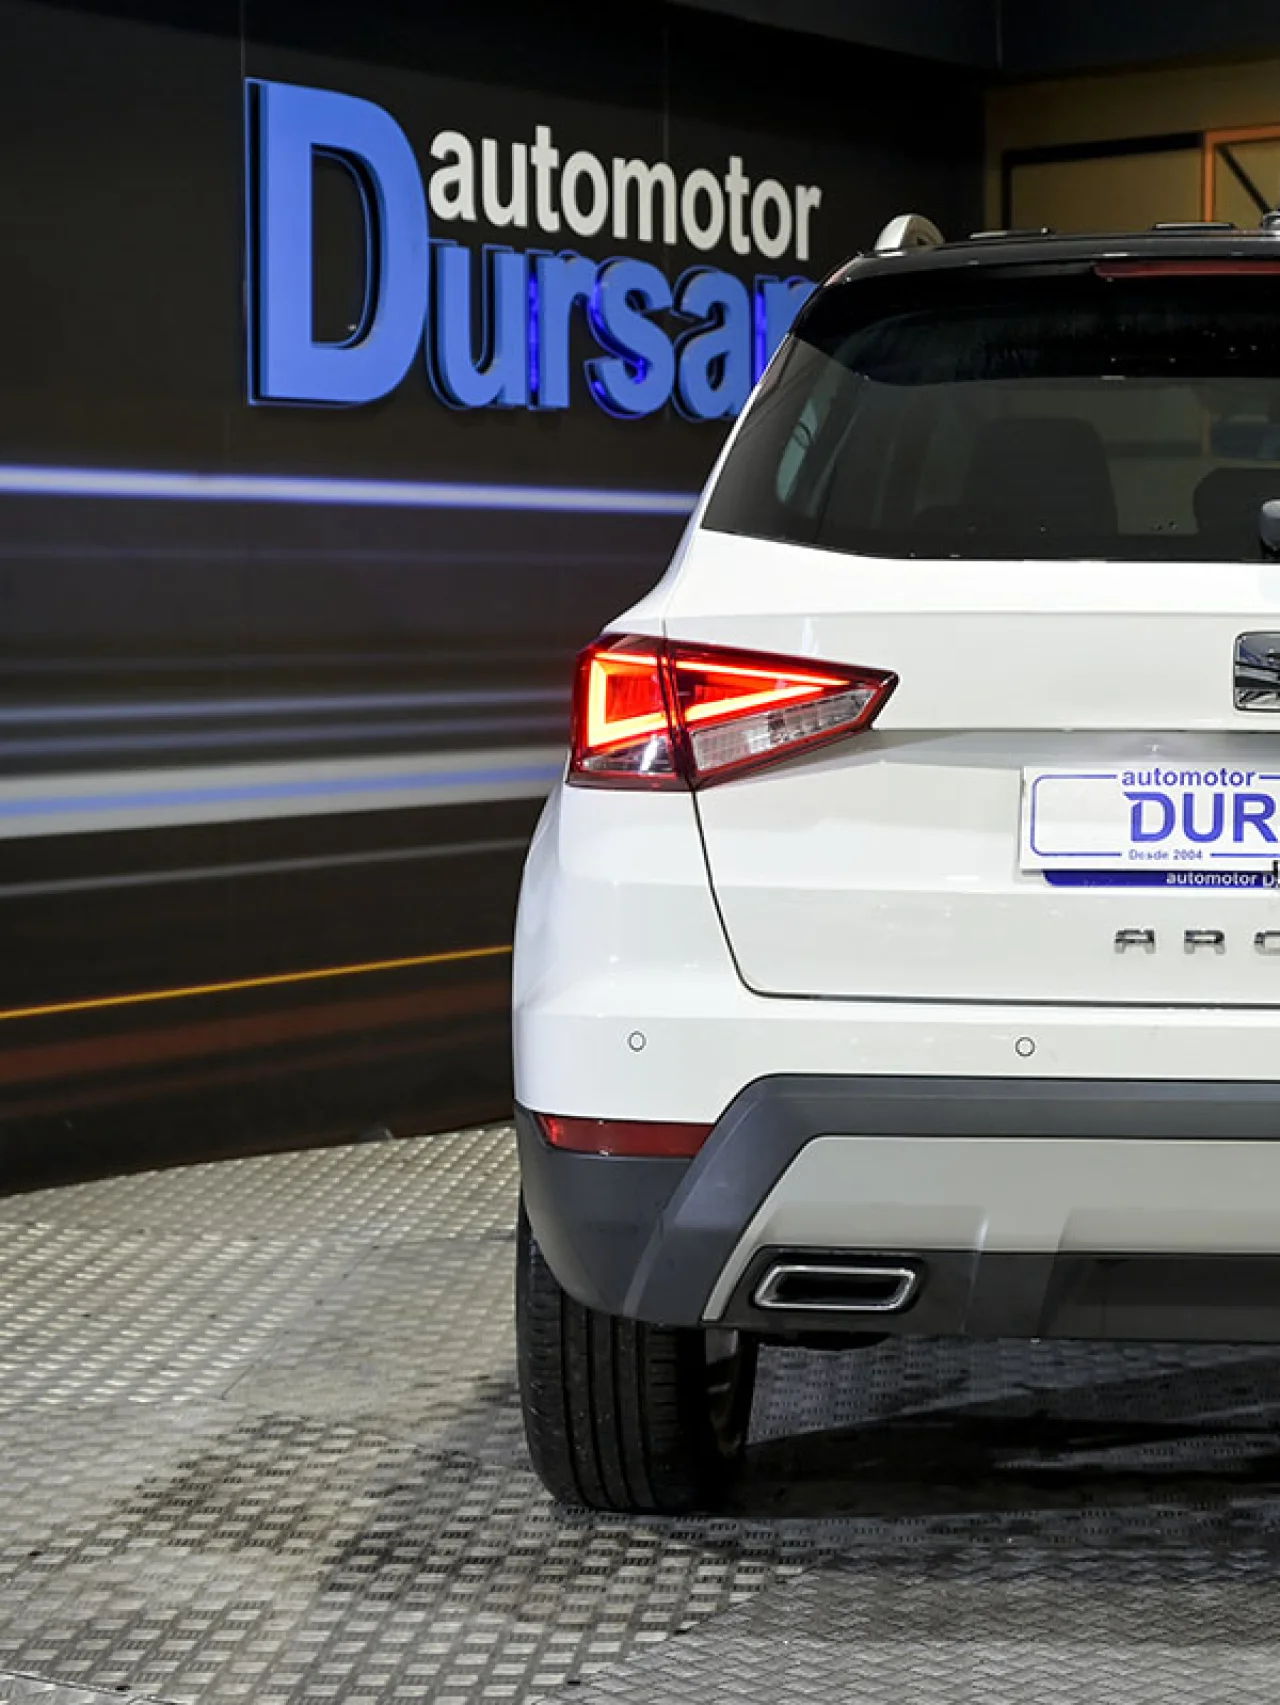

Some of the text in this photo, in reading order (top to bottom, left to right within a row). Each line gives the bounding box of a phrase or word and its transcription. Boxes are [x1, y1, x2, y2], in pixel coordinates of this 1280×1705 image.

[429, 125, 821, 260] automotor
[1121, 767, 1256, 787] automotor
[1128, 848, 1203, 861] Desde 2004
[1166, 872, 1257, 886] automotor
